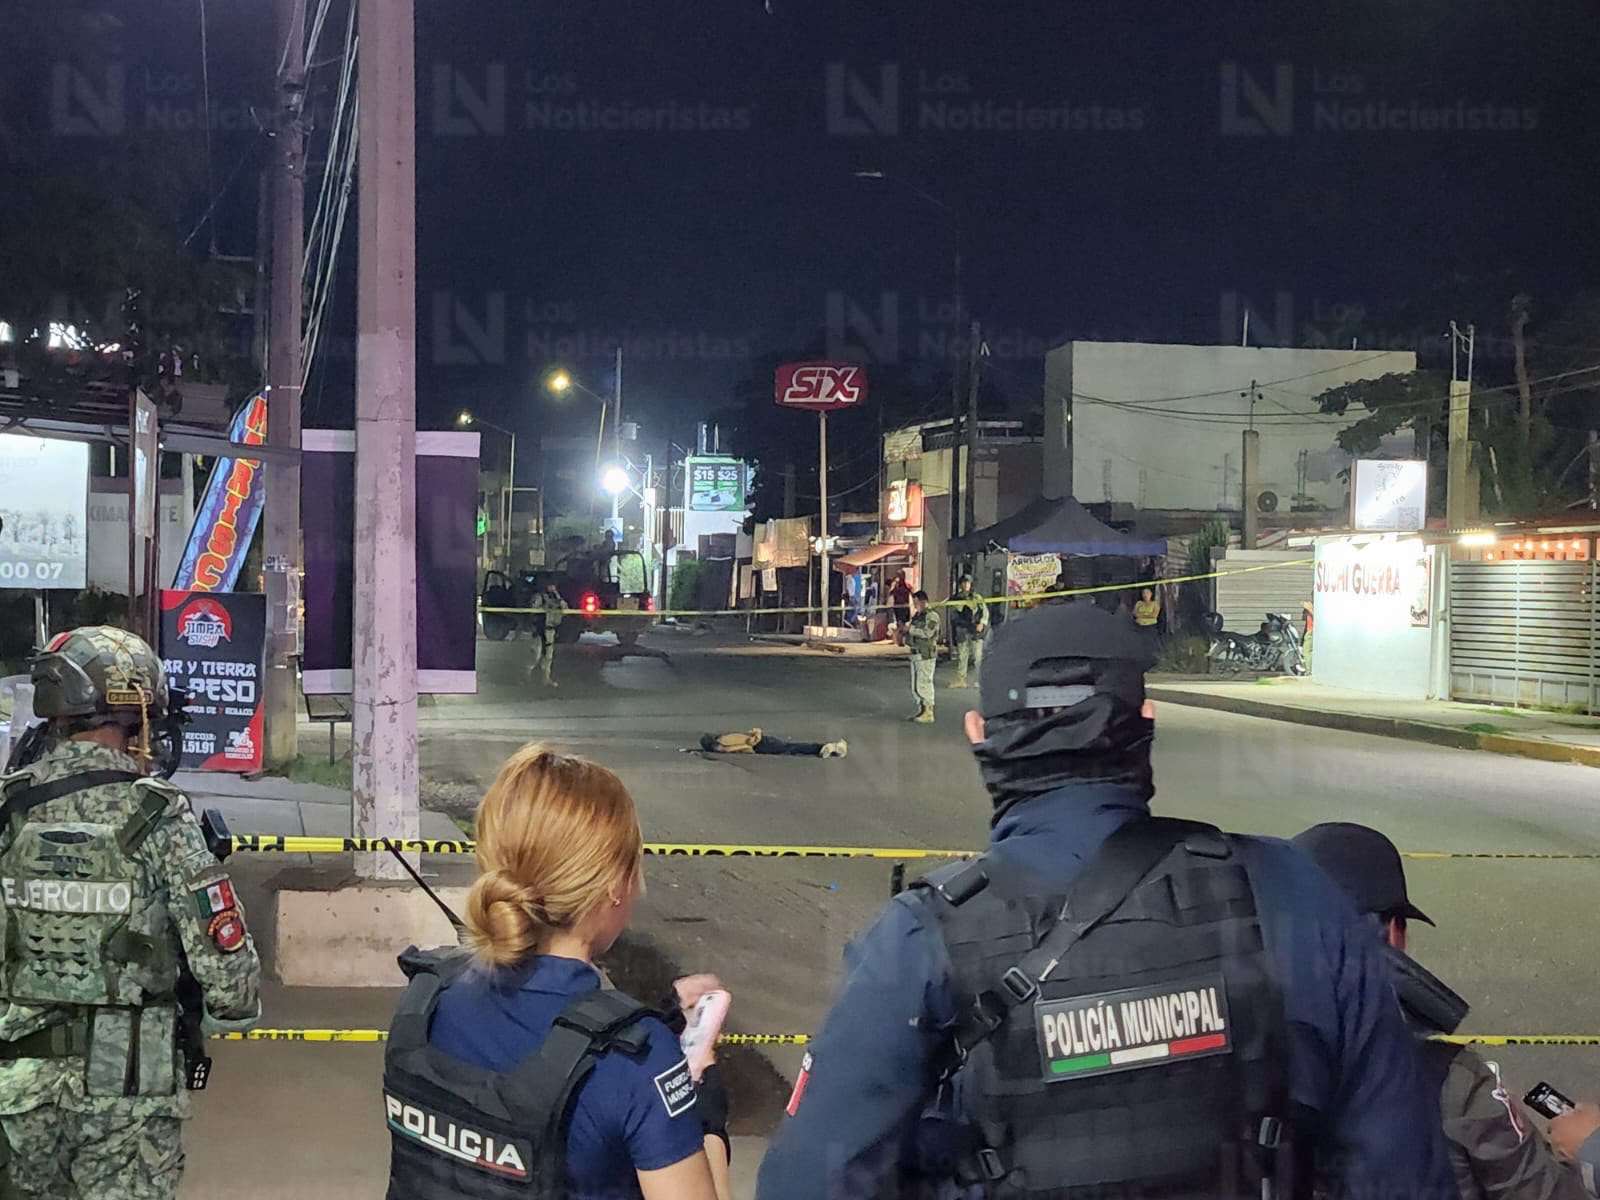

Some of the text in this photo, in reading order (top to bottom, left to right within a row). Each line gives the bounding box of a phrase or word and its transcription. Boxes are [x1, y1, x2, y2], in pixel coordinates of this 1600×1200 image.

[35, 562, 63, 579] 07
[163, 659, 183, 674] AR
[201, 661, 257, 677] TIERRA
[186, 678, 256, 703] PESO
[1043, 987, 1225, 1058] POLICÍA MUNICIPAL
[386, 1094, 526, 1170] POLICIA
